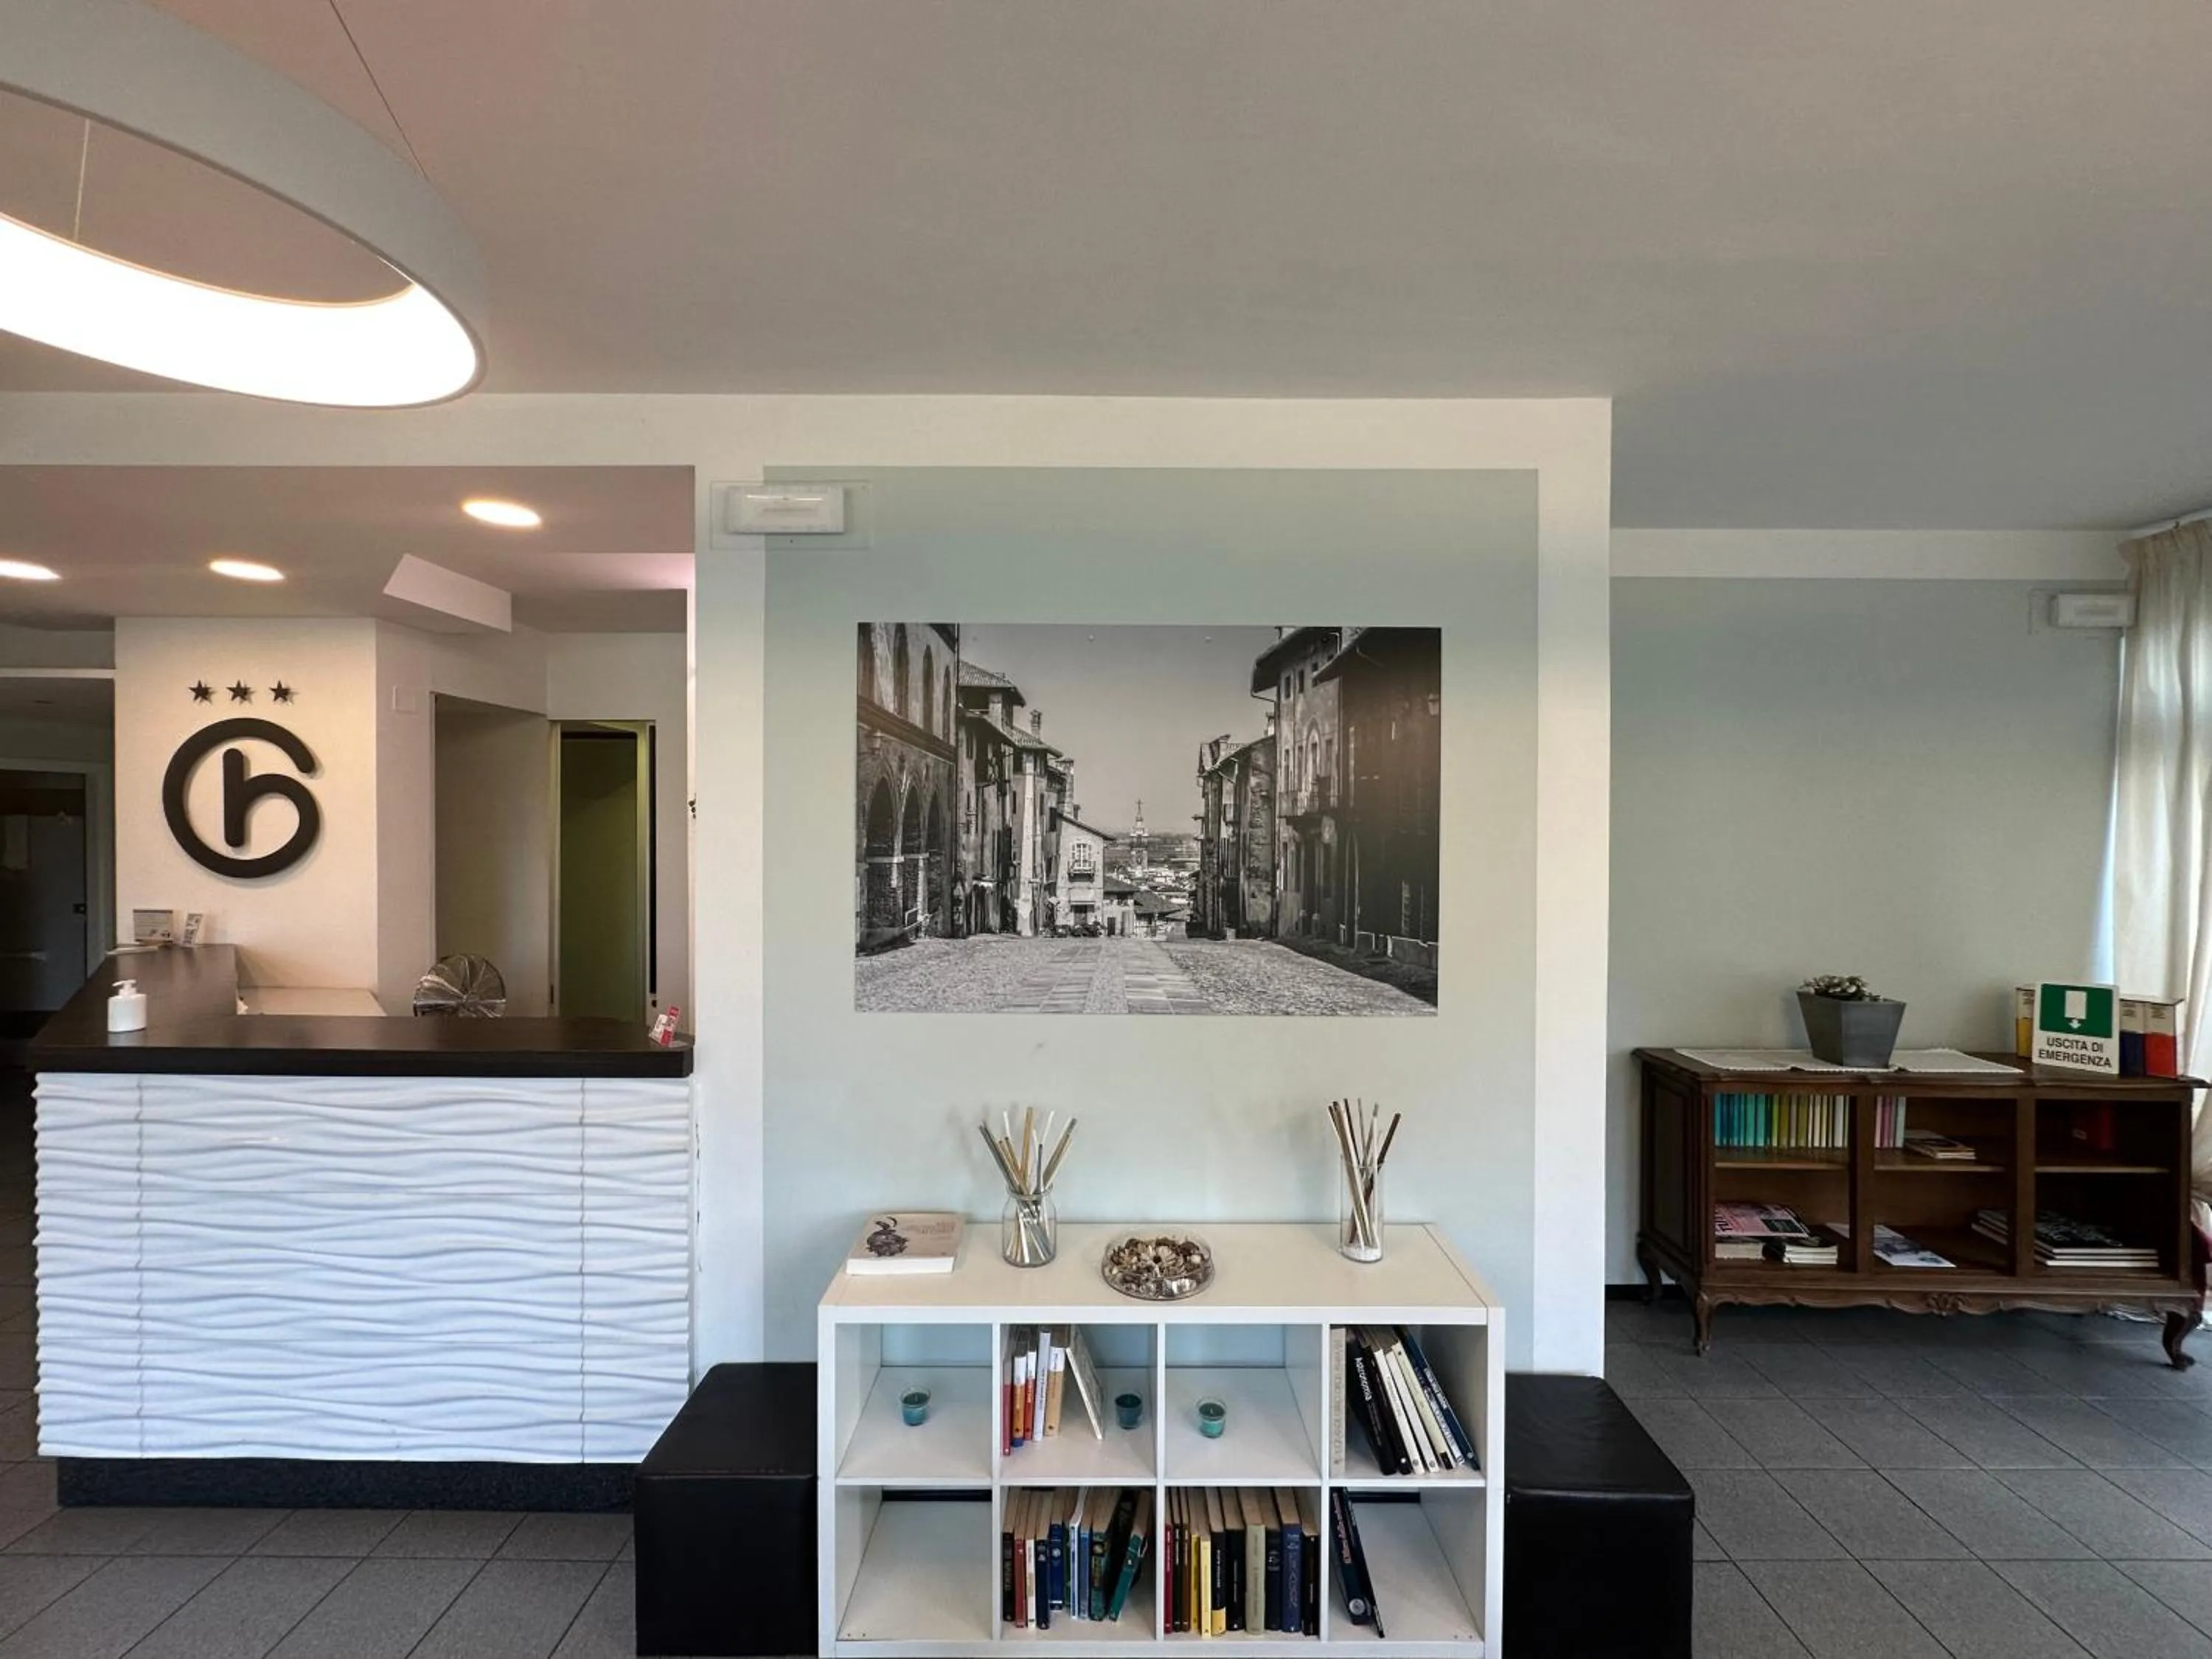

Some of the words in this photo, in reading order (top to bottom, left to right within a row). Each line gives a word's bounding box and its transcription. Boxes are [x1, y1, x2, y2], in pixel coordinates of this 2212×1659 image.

[2047, 1037, 2088, 1051] USCITA
[2092, 1042, 2104, 1053] DI
[2038, 1048, 2112, 1068] EMERGENZA
